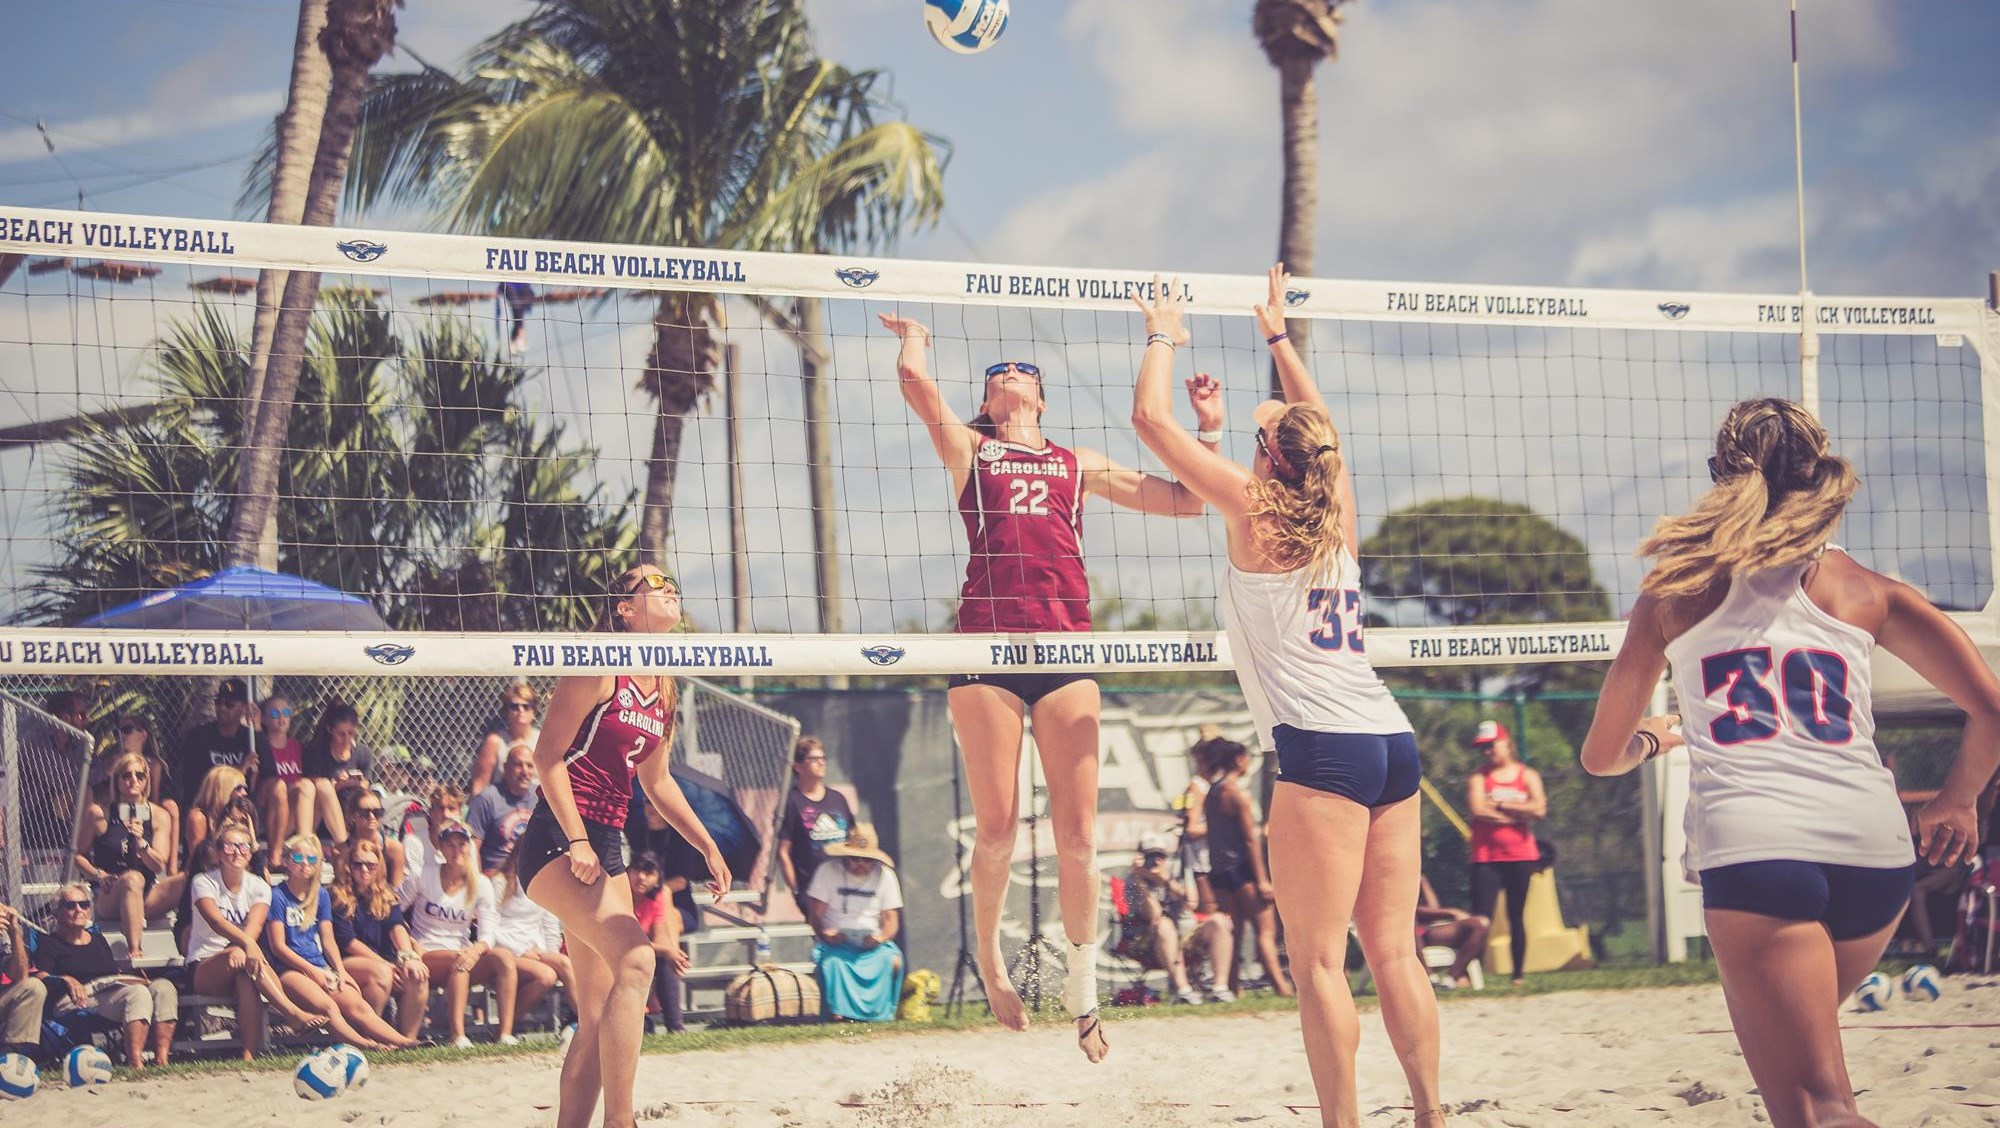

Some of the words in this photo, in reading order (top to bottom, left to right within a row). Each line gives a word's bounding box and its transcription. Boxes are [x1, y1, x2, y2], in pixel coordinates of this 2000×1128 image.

[0, 217, 73, 245] BEACH
[82, 223, 235, 254] VOLLEYBALL
[486, 248, 528, 271] FAU
[535, 251, 605, 275] BEACH
[612, 255, 746, 282] VOLLEYBALL
[966, 274, 1002, 294] FAU
[1009, 276, 1070, 297] BEACH
[1077, 279, 1193, 302] VOLLEYBAL
[1387, 292, 1419, 311] FAU
[1426, 294, 1478, 314] BEACH
[1485, 296, 1588, 316] VOLLEYBALL
[1758, 305, 1786, 322] FAU
[1844, 307, 1935, 324] VOLLEYBALL
[990, 460, 1069, 479] CAROLINA
[1009, 478, 1049, 515] 22
[22, 641, 103, 664] BEACH
[109, 642, 264, 666] VOLLEYBALL
[512, 644, 554, 667] FAU
[561, 645, 633, 667] BEACH
[638, 645, 773, 667] VOLLEYBALL
[991, 645, 1028, 666] FAU
[1033, 644, 1096, 665] BEACH
[1101, 642, 1218, 664] VOLLEYBALL
[1410, 638, 1442, 659] FAU
[1448, 637, 1502, 658] BEACH
[1507, 634, 1610, 656] VOLLEYBALL
[1701, 647, 1854, 746] 30
[618, 709, 664, 738] CAROLIN
[625, 735, 646, 769] 2
